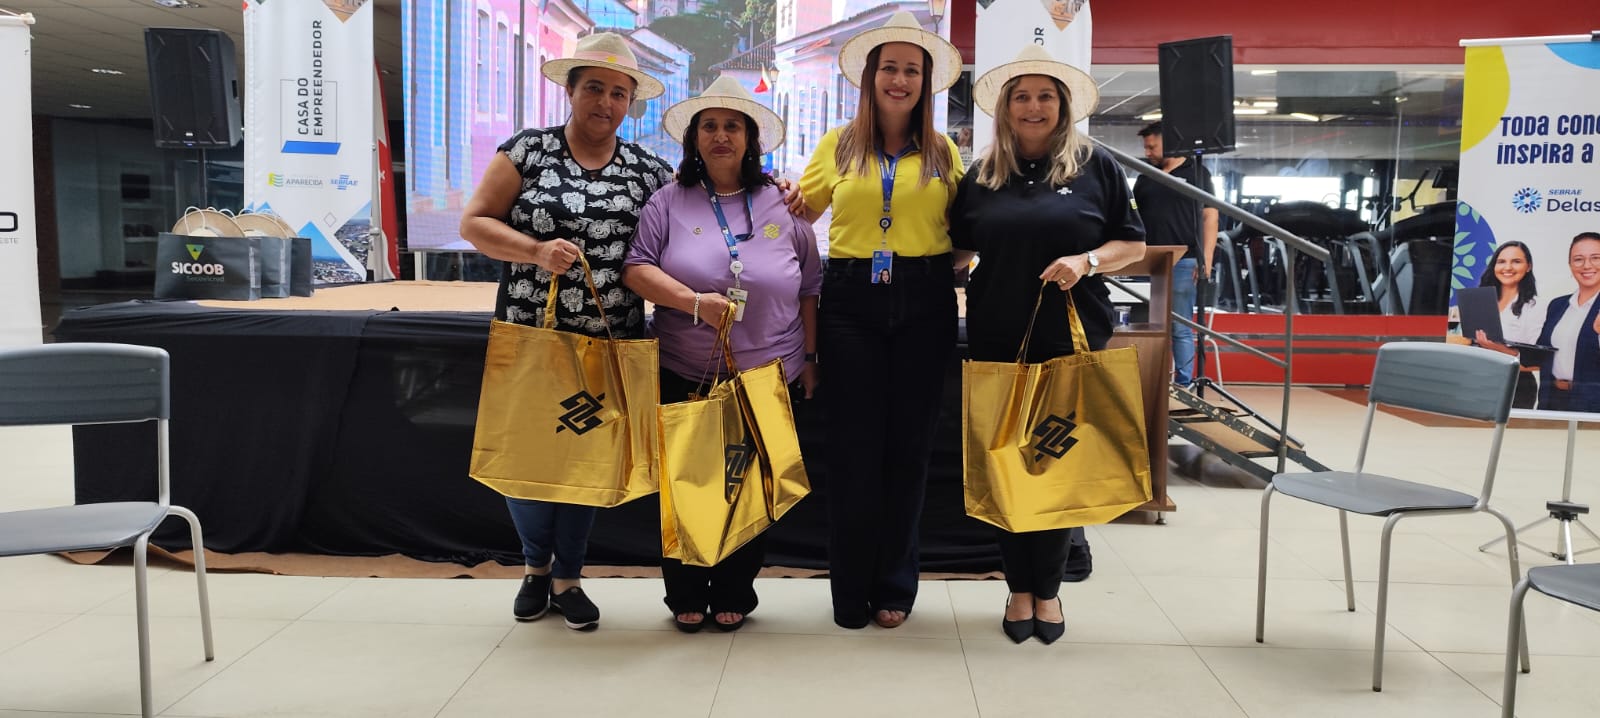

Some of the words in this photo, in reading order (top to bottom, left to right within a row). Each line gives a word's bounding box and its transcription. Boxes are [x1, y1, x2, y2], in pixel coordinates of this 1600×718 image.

[297, 77, 309, 96] DO
[312, 19, 323, 136] EMPREENDEDOR
[298, 100, 309, 135] CASA
[171, 261, 225, 276] SICOOB
